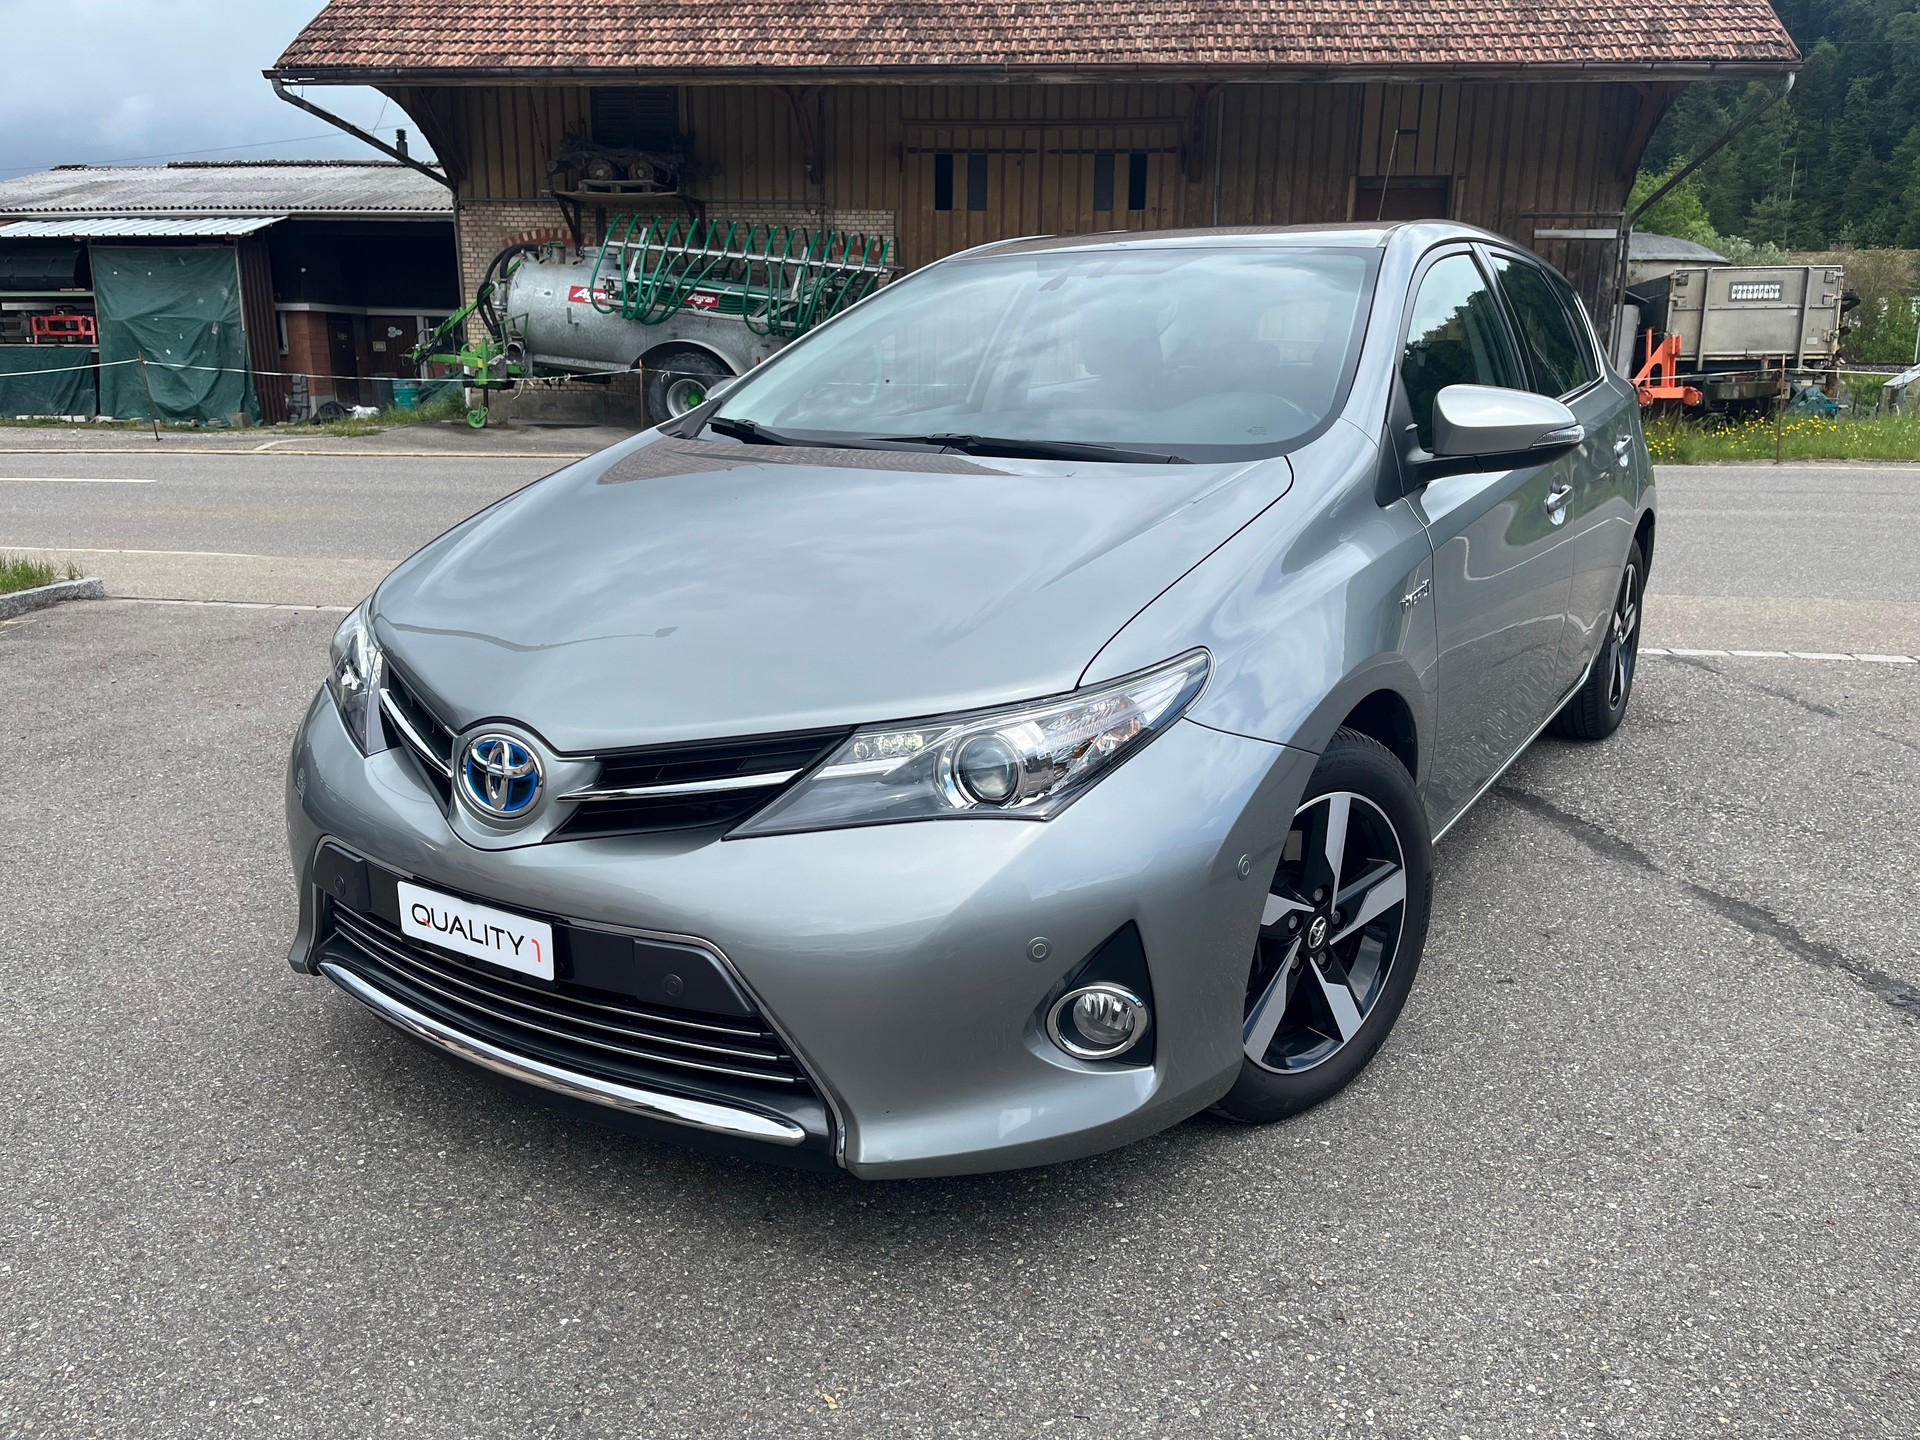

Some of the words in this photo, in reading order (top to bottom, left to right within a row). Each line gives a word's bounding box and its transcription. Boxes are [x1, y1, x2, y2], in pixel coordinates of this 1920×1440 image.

[572, 287, 613, 303] Agra
[687, 292, 716, 305] Agrar
[411, 903, 525, 956] QUALITY
